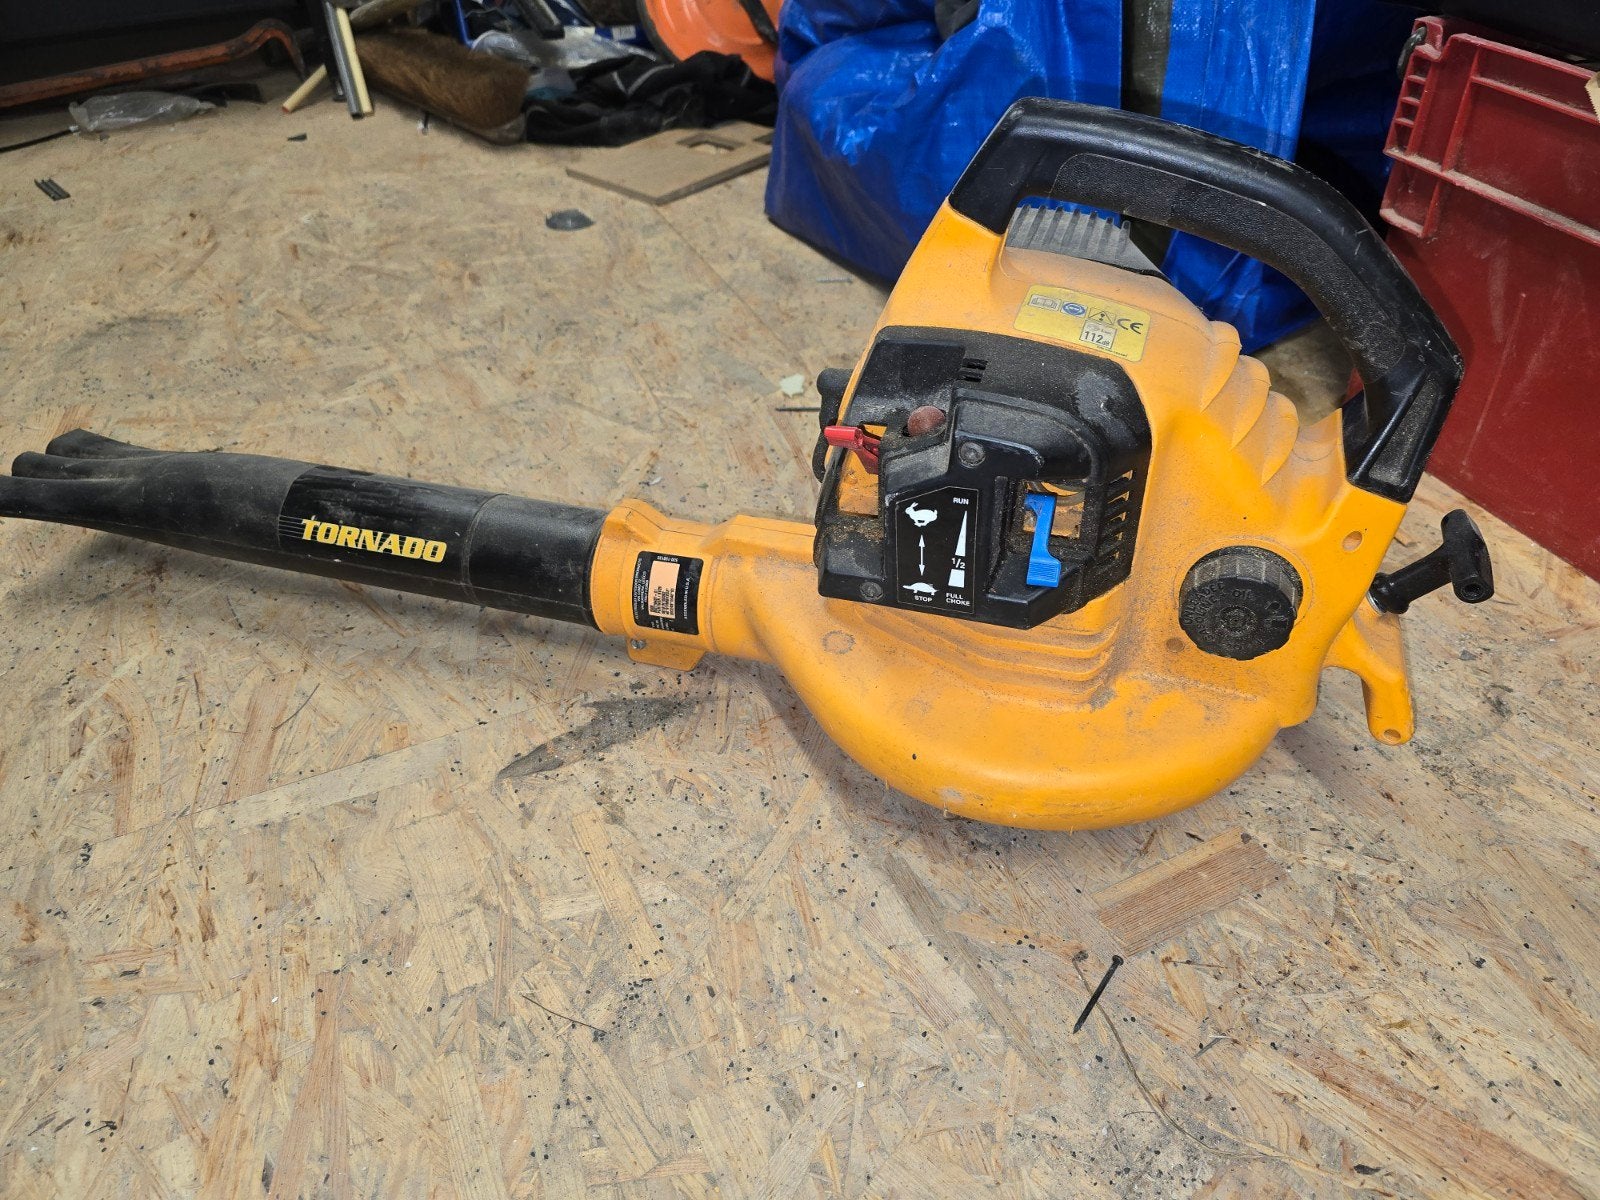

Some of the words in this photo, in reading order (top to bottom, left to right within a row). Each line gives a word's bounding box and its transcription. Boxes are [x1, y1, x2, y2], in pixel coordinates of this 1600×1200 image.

[1084, 331, 1103, 344] 112
[953, 497, 969, 505] RUN
[301, 518, 448, 564] TORNADO
[951, 557, 966, 569] 1/2
[946, 592, 963, 600] FULL
[946, 598, 970, 606] CHOKE
